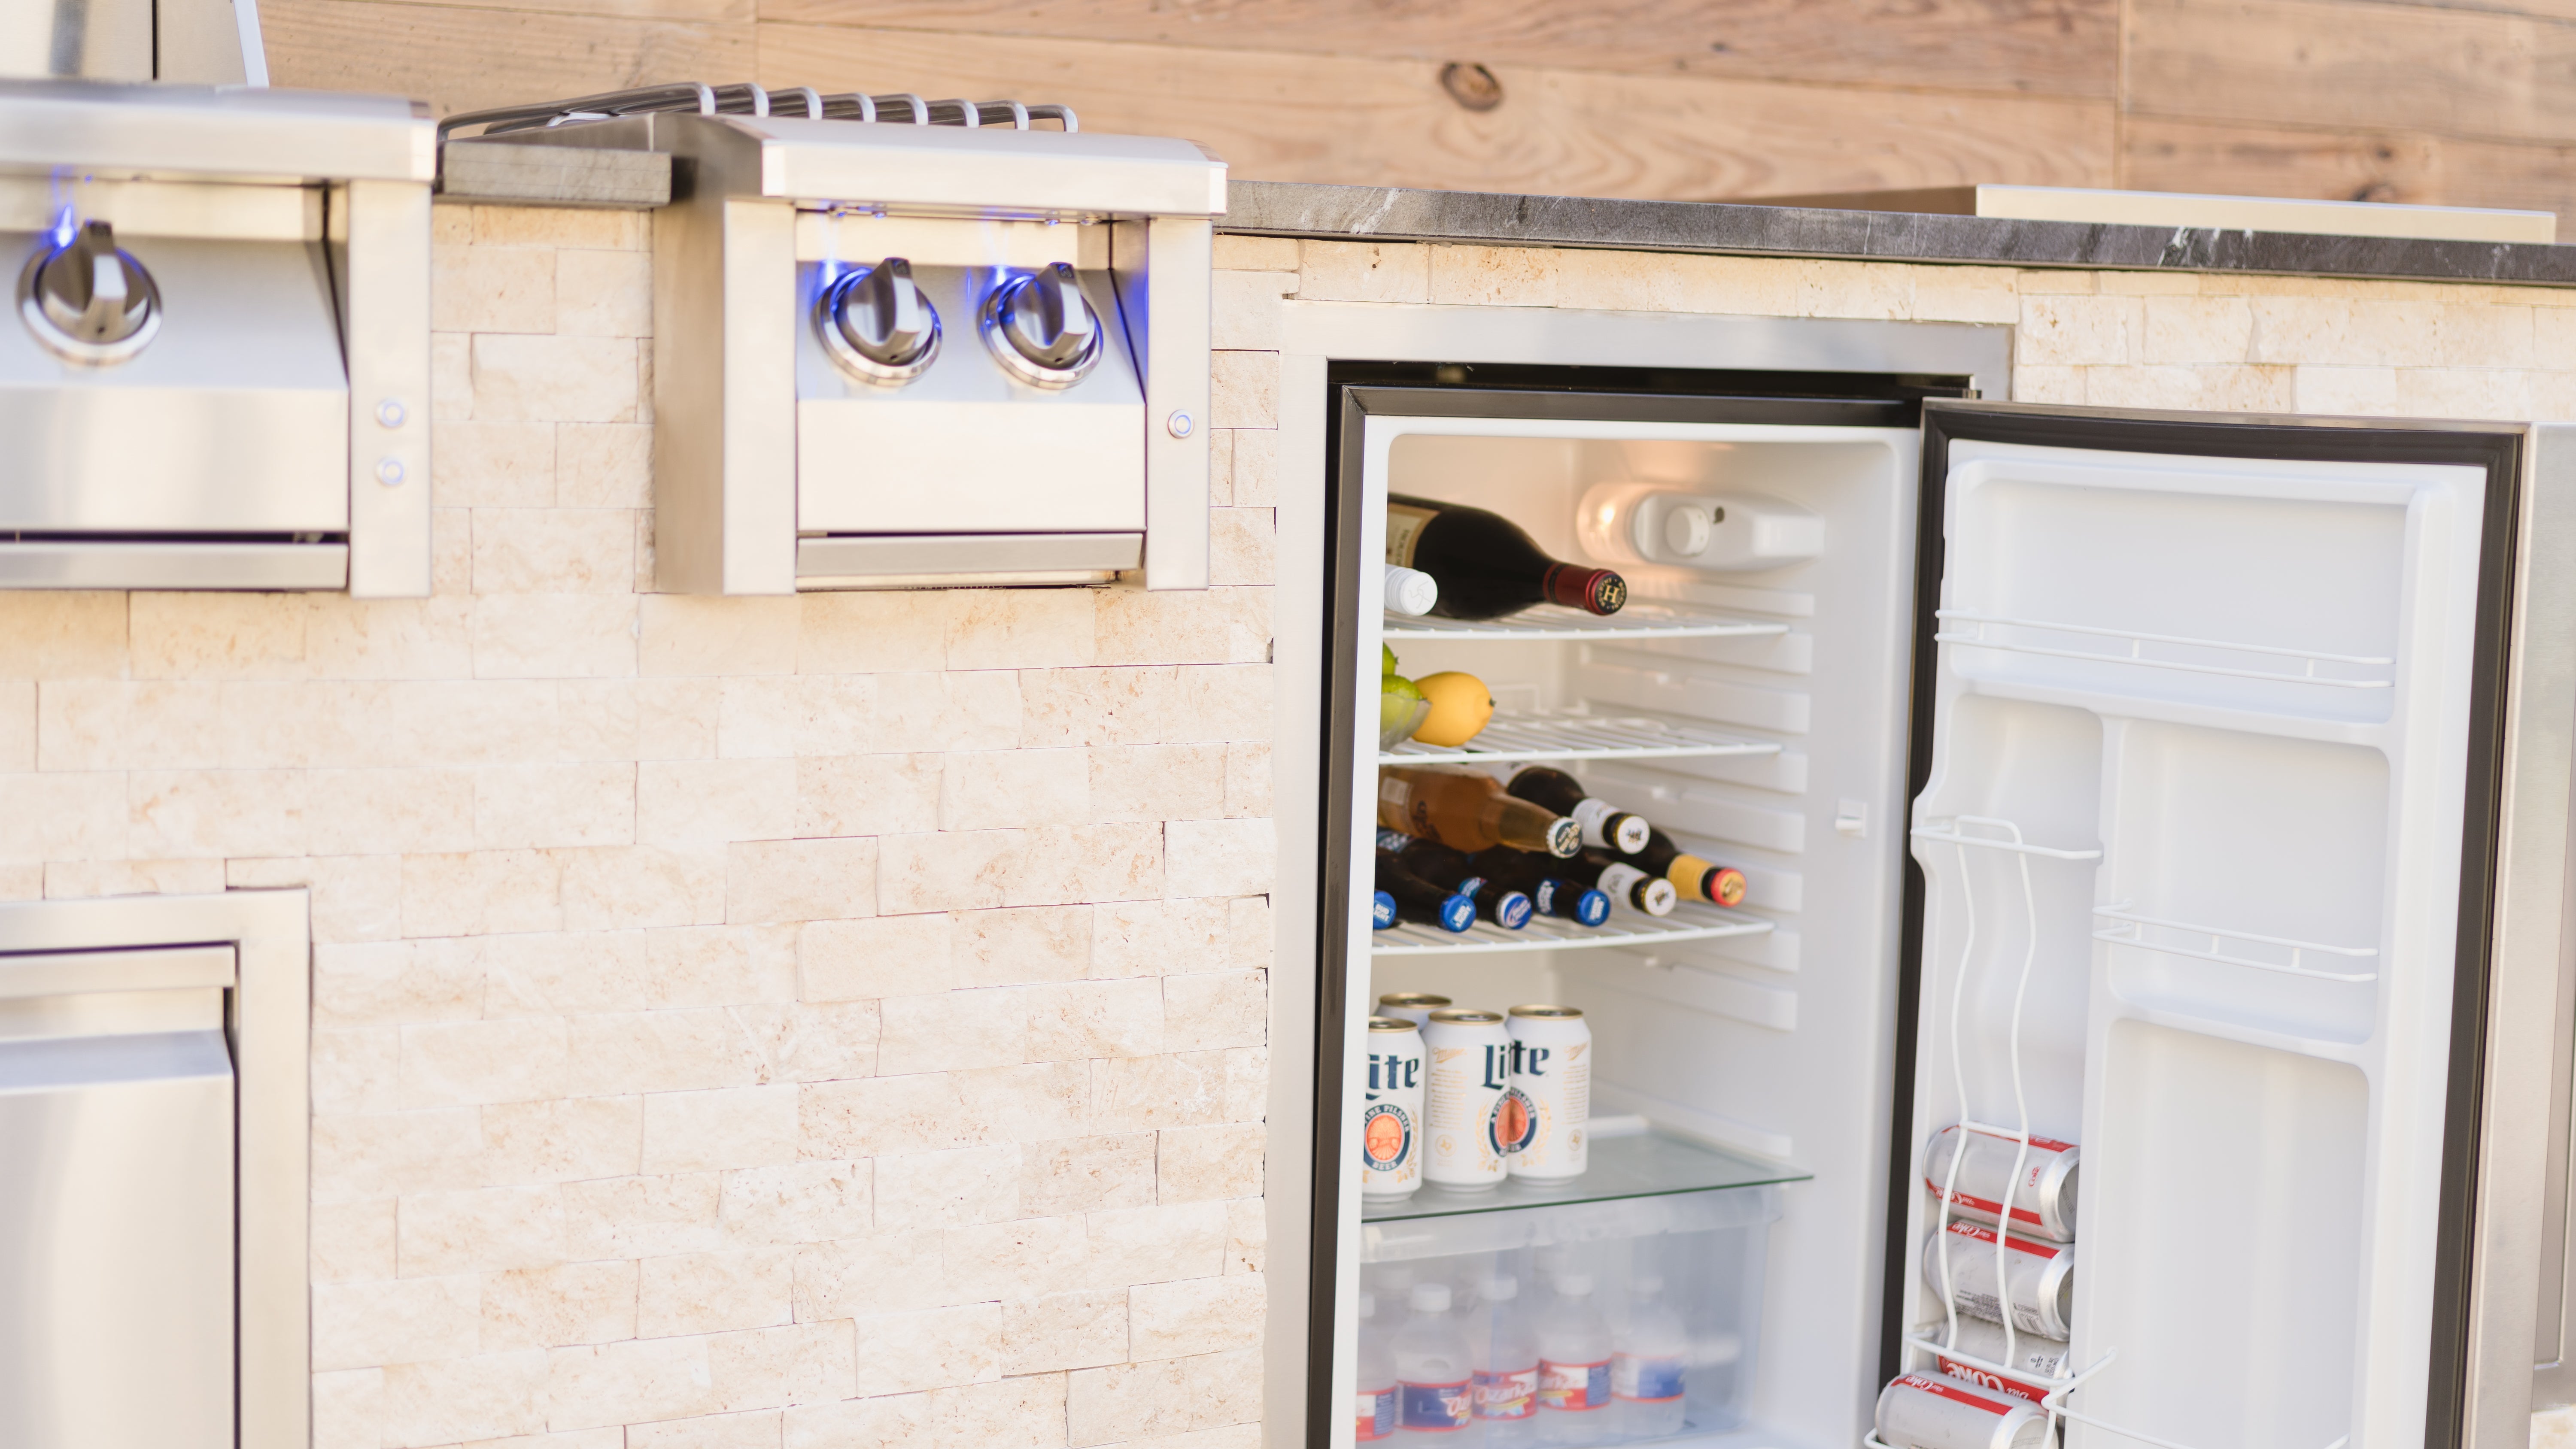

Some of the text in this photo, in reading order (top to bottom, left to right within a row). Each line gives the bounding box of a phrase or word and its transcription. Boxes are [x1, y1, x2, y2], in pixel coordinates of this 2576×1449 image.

[1603, 585, 1620, 603] H
[1373, 908, 1390, 922] IGHT
[1384, 1105, 1409, 1132] PILSNER
[1372, 1161, 1397, 1170] BEER
[1935, 1186, 1962, 1204] Coe
[1952, 1222, 1981, 1237] Coke
[1905, 1375, 1934, 1390] Coke
[1946, 1363, 2005, 1393] Coke
